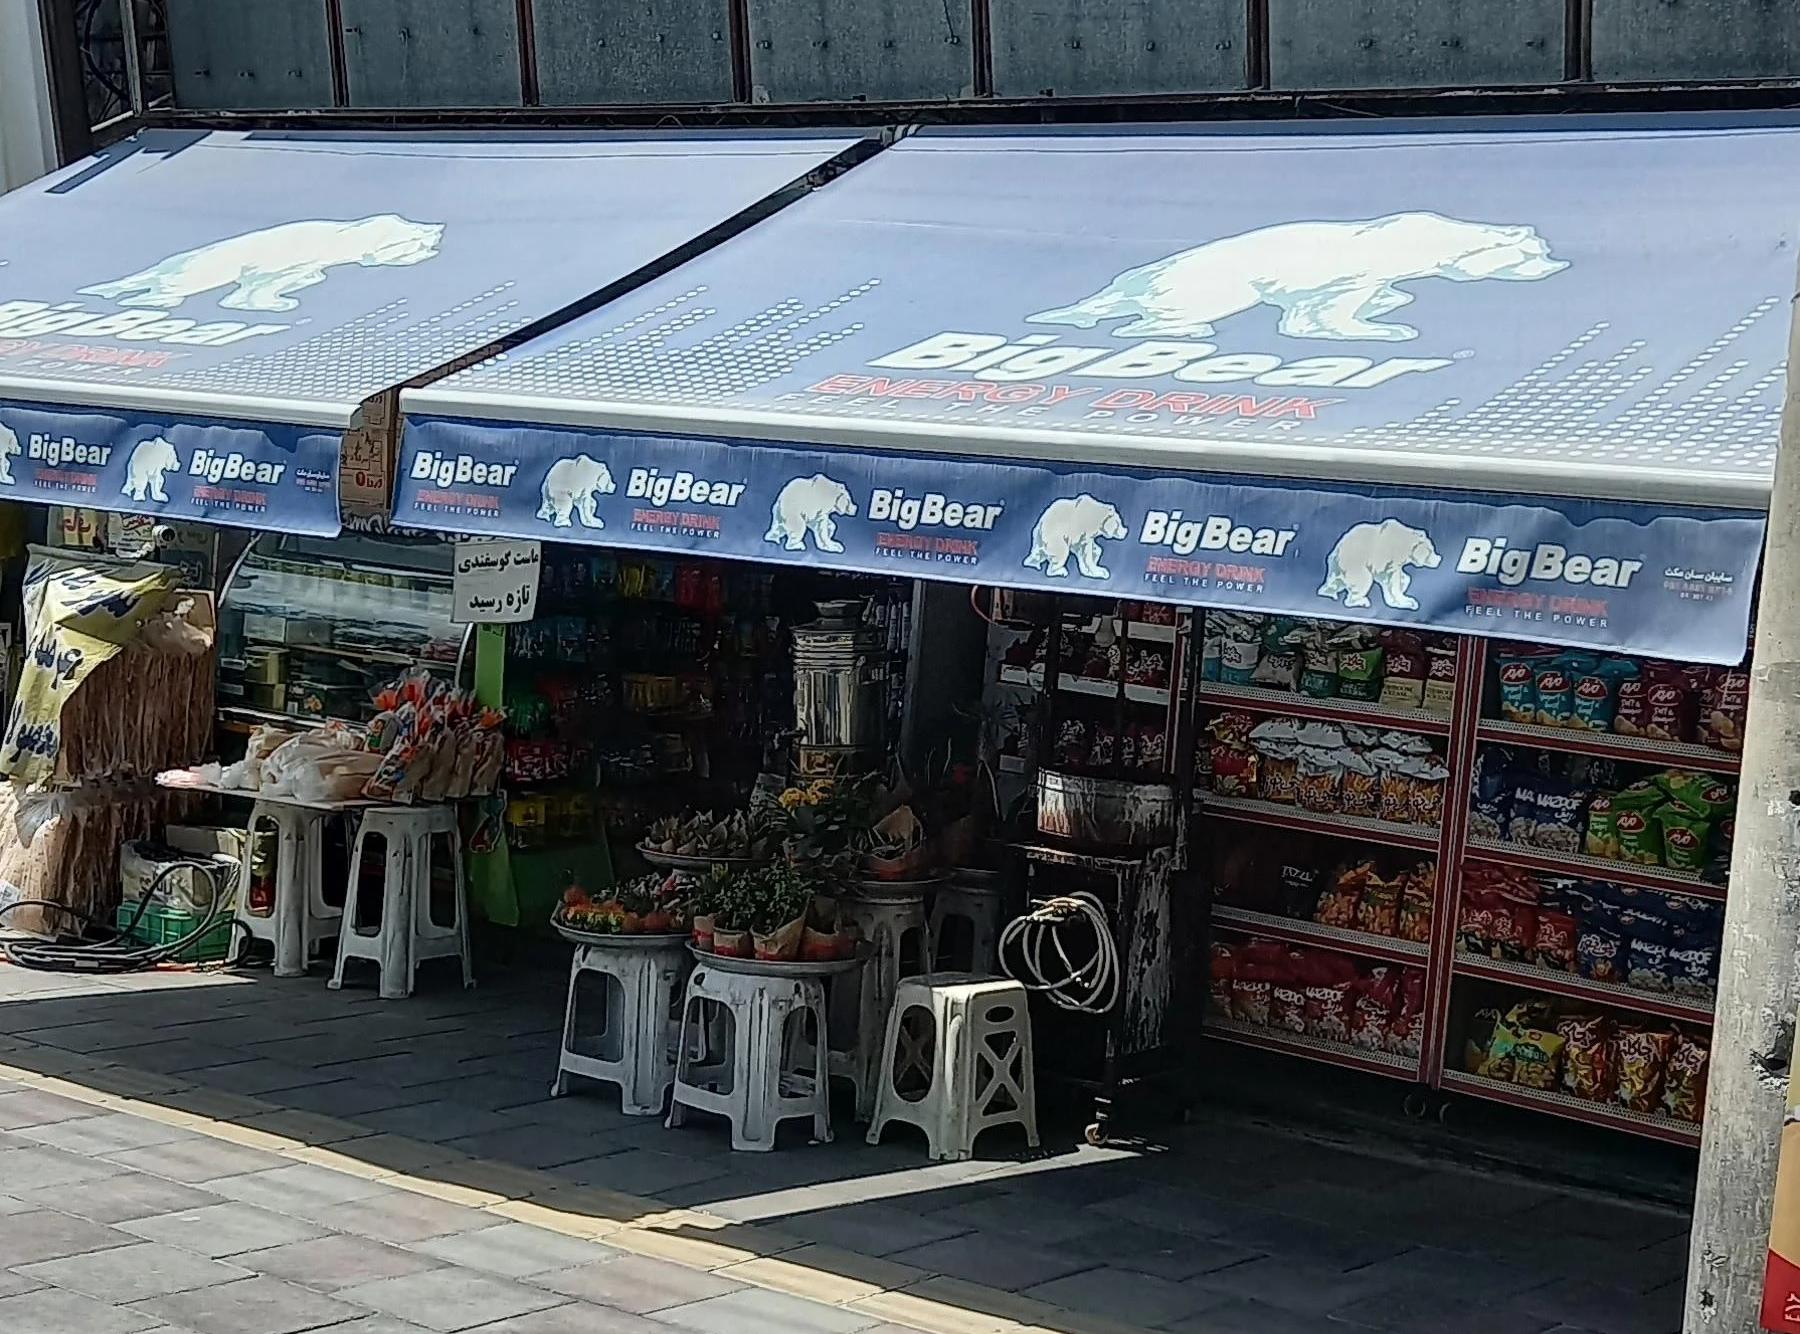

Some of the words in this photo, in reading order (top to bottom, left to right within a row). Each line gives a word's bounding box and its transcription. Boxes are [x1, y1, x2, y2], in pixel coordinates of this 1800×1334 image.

[868, 332, 1460, 389] BigBear
[774, 393, 900, 410] FEEL
[943, 401, 1050, 418] THE
[1083, 410, 1302, 431] POWER
[804, 373, 1102, 405] ENERGY
[1087, 388, 1347, 419] DRINK
[28, 433, 112, 466] BigBear
[188, 449, 286, 484] BigBear
[410, 451, 518, 488] BigBear
[625, 468, 747, 507] BigBear
[868, 488, 1003, 530] BigBear
[630, 522, 654, 533] FEEL
[659, 525, 678, 535] THE
[682, 527, 721, 539] POWER
[1139, 510, 1297, 556] BigBear
[458, 549, 512, 573] گوسفندی
[513, 548, 539, 566] ماست
[874, 546, 904, 558] FEEL
[909, 549, 931, 561] THE
[936, 553, 979, 566] POWER
[1456, 537, 1643, 588] BigBear
[506, 585, 531, 614] تازه
[1143, 571, 1176, 584] FEEL
[1183, 576, 1209, 588] THE
[1216, 580, 1266, 595] POWER
[469, 595, 503, 614] رسید
[1465, 604, 1504, 618] FEEL
[1514, 609, 1543, 622] THE
[1552, 613, 1609, 629] POWER
